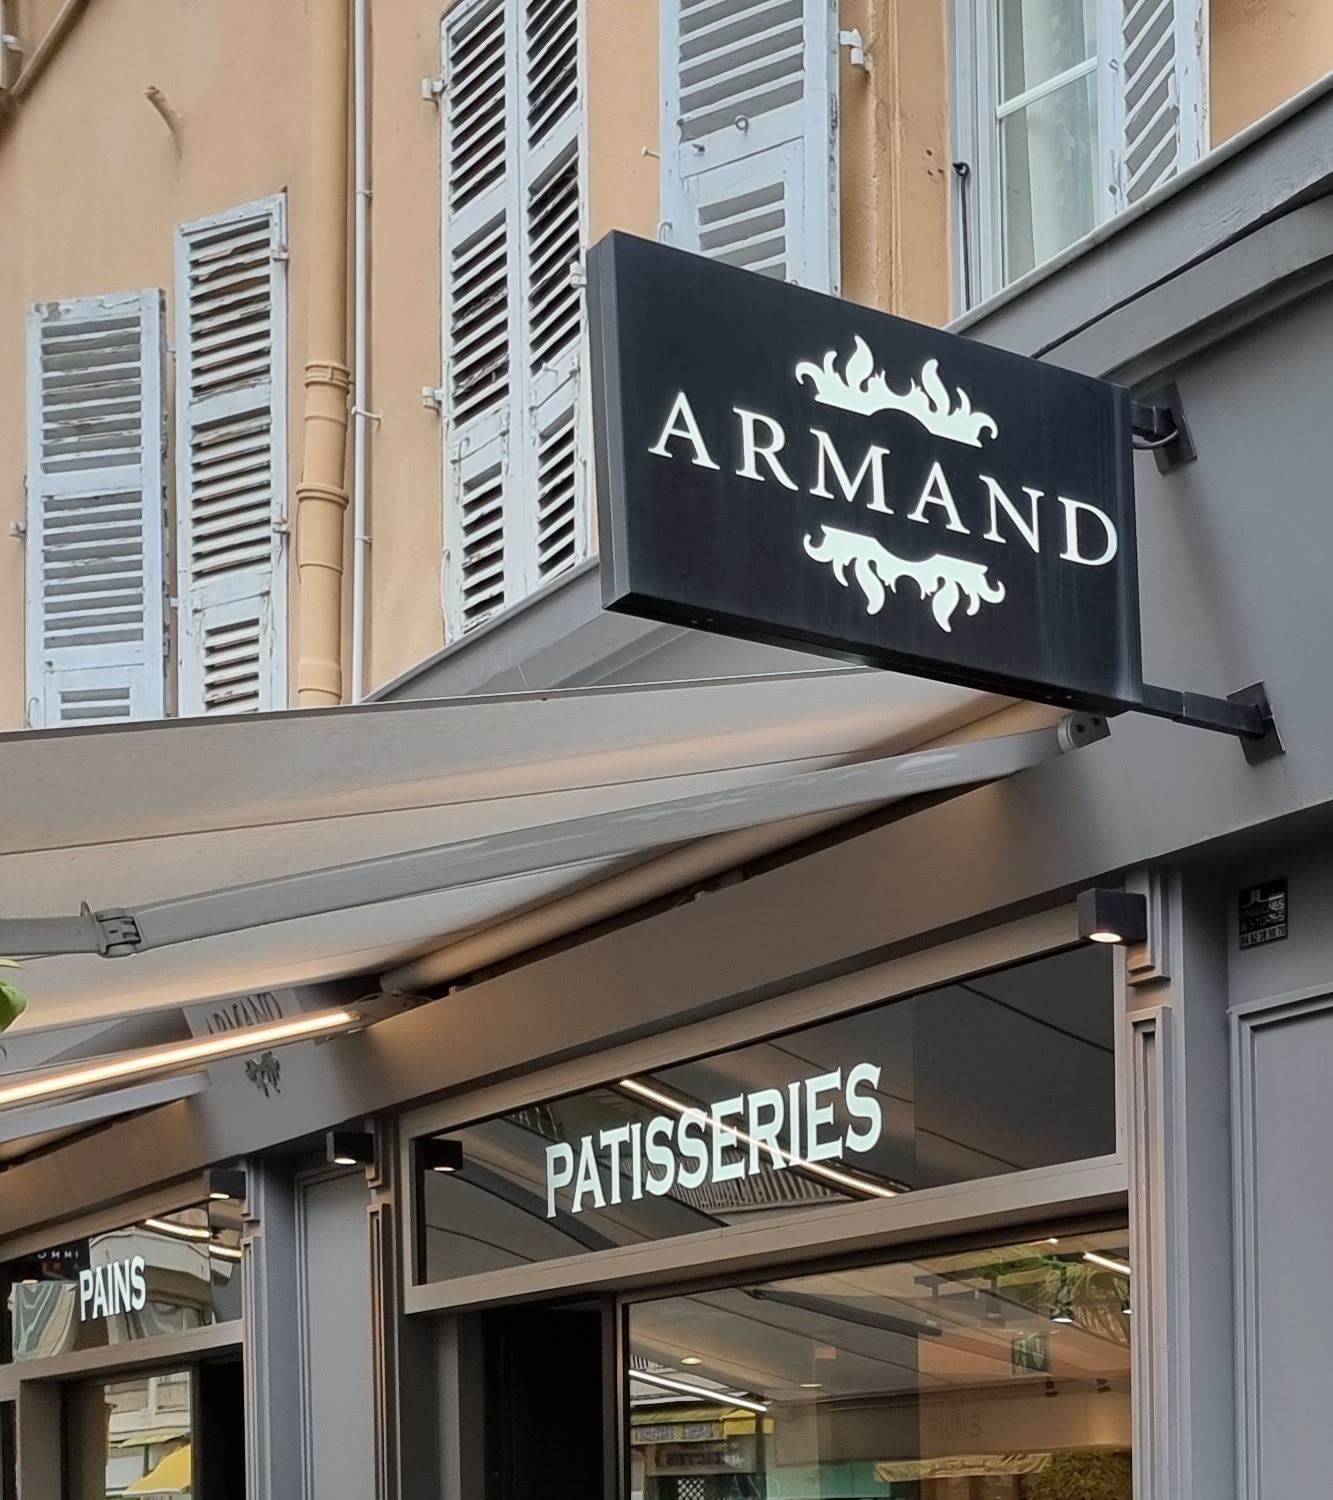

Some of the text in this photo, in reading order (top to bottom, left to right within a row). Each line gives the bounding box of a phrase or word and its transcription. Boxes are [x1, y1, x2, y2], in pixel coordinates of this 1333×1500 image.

[648, 391, 1118, 566] ARMAND
[545, 1062, 882, 1218] PATISSERIES
[79, 1255, 146, 1322] PAINS
